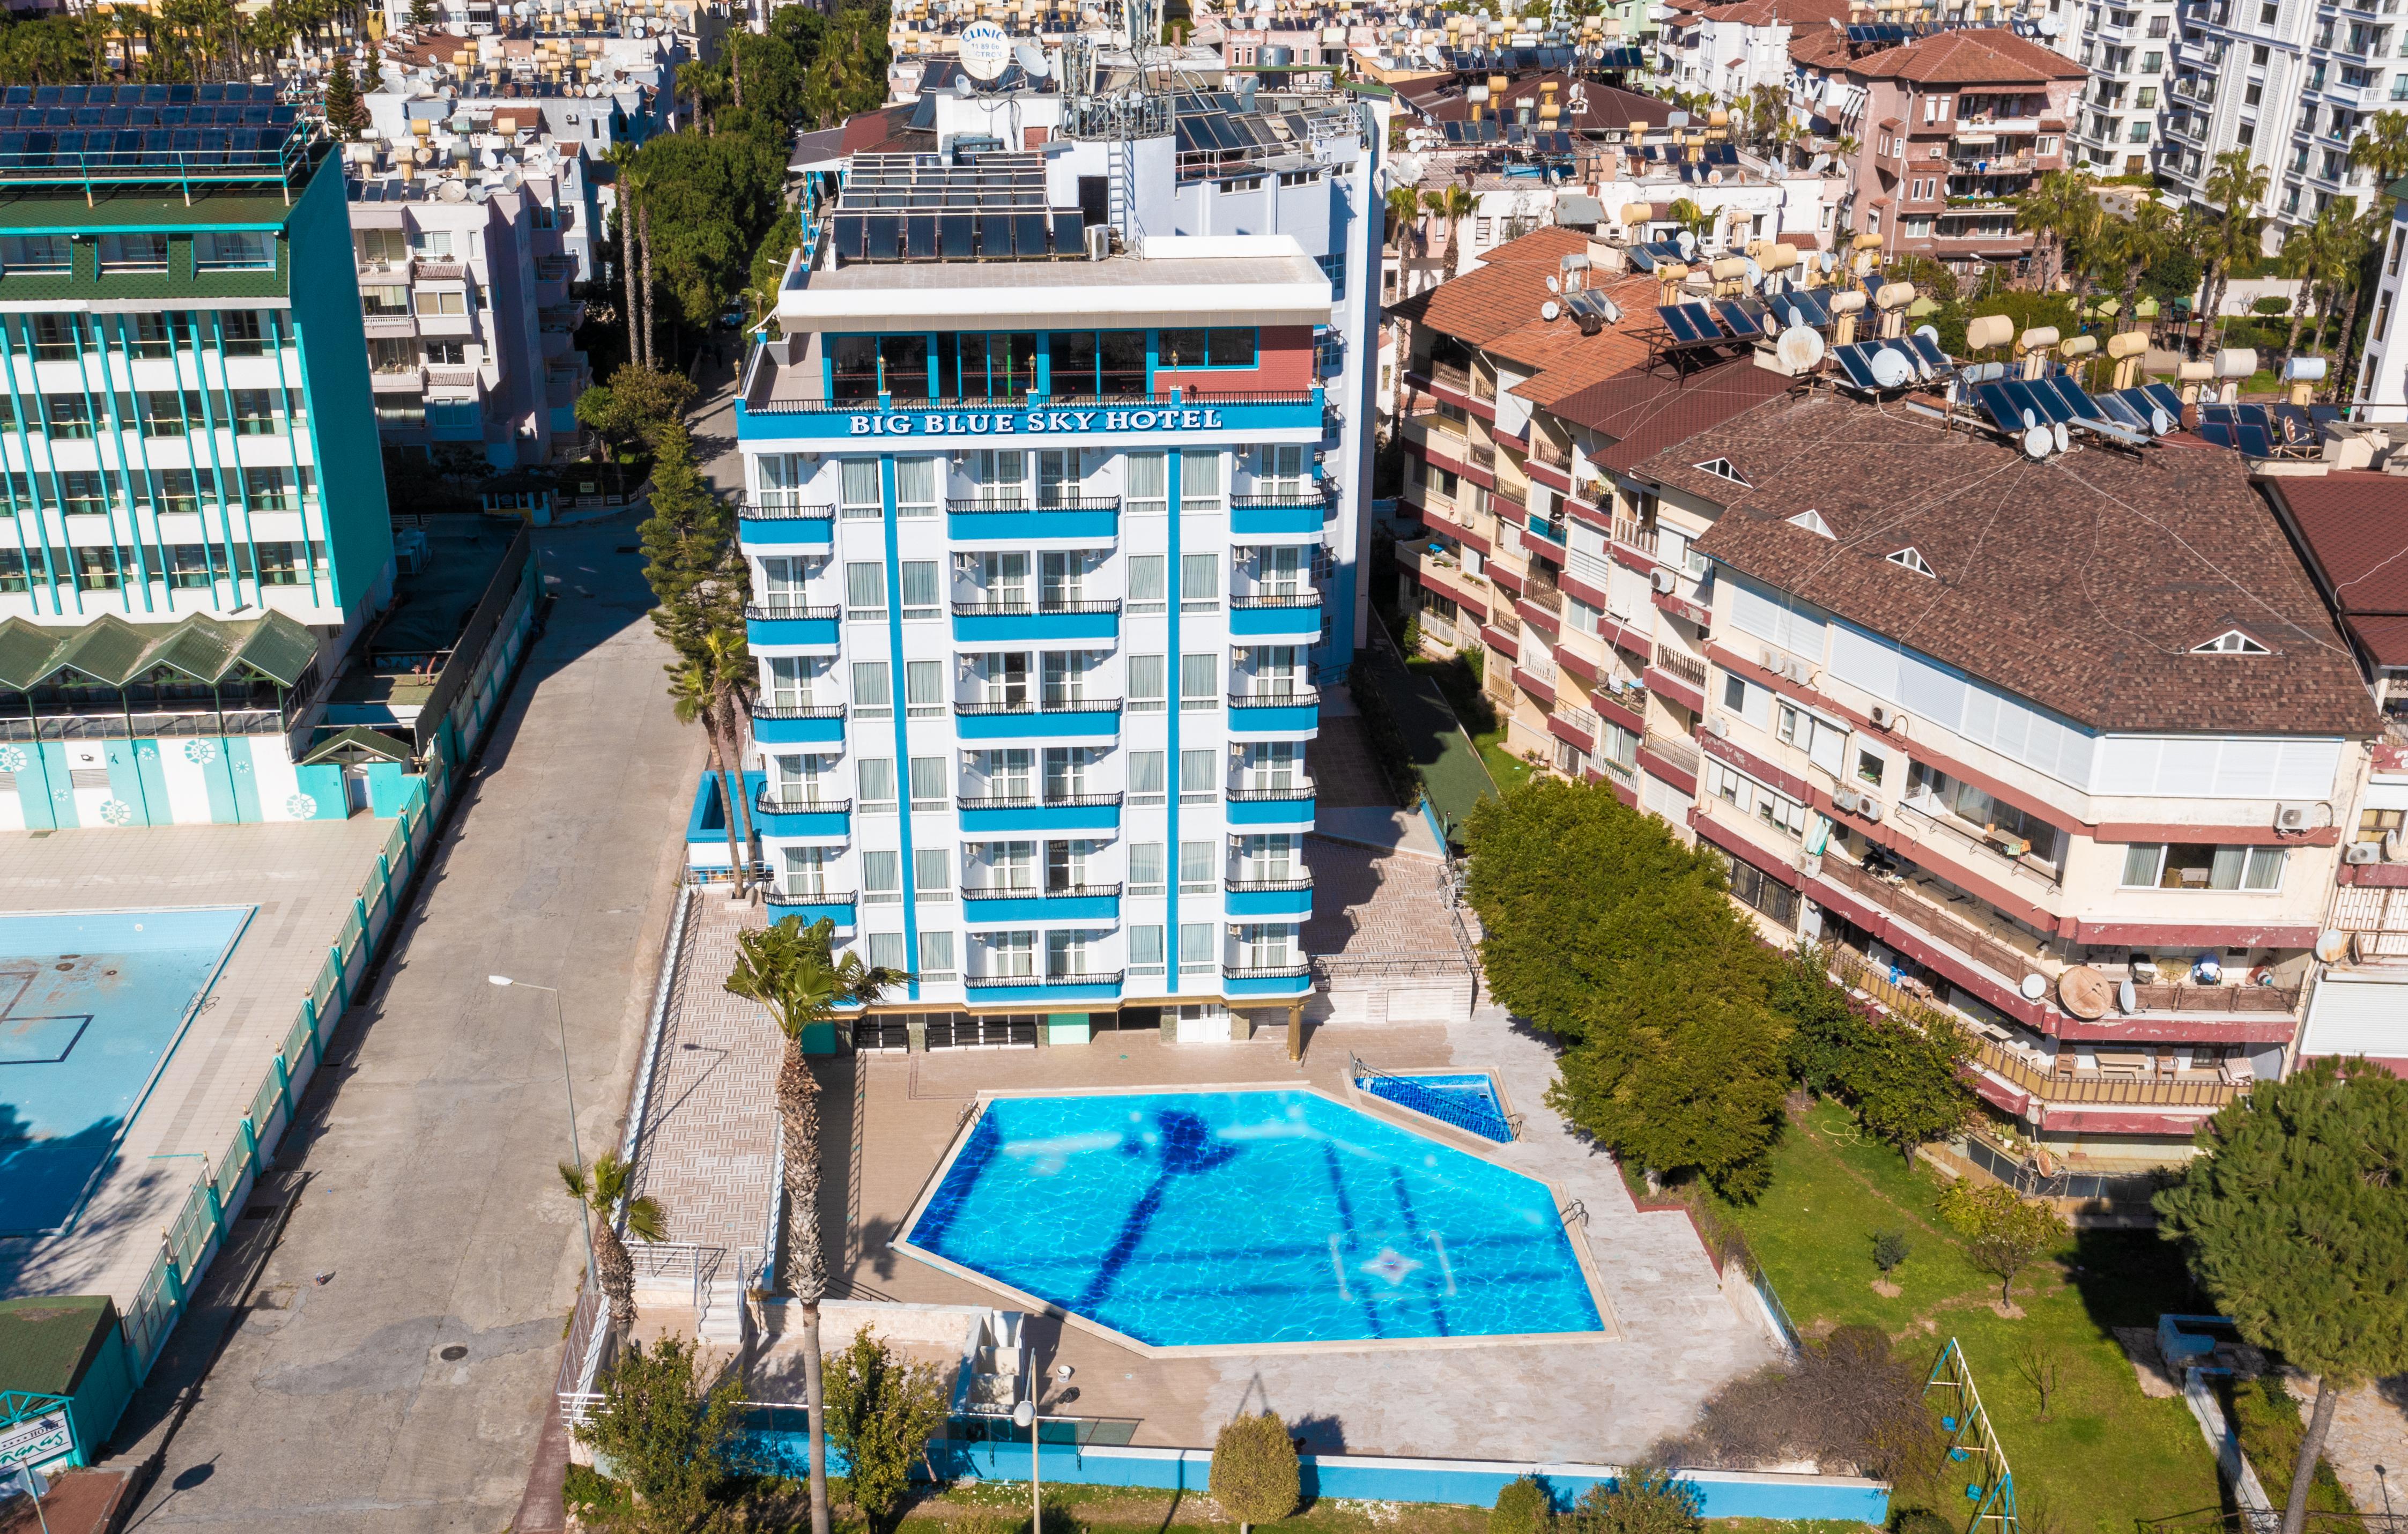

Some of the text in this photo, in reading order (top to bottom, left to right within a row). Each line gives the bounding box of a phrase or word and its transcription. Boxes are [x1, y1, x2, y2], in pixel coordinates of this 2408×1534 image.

[962, 27, 1004, 42] CLINIC
[850, 410, 1221, 434] BIG BLUE SKY HOTEL
[30, 1422, 62, 1437] HOTEL
[0, 1431, 63, 1464] nanas
